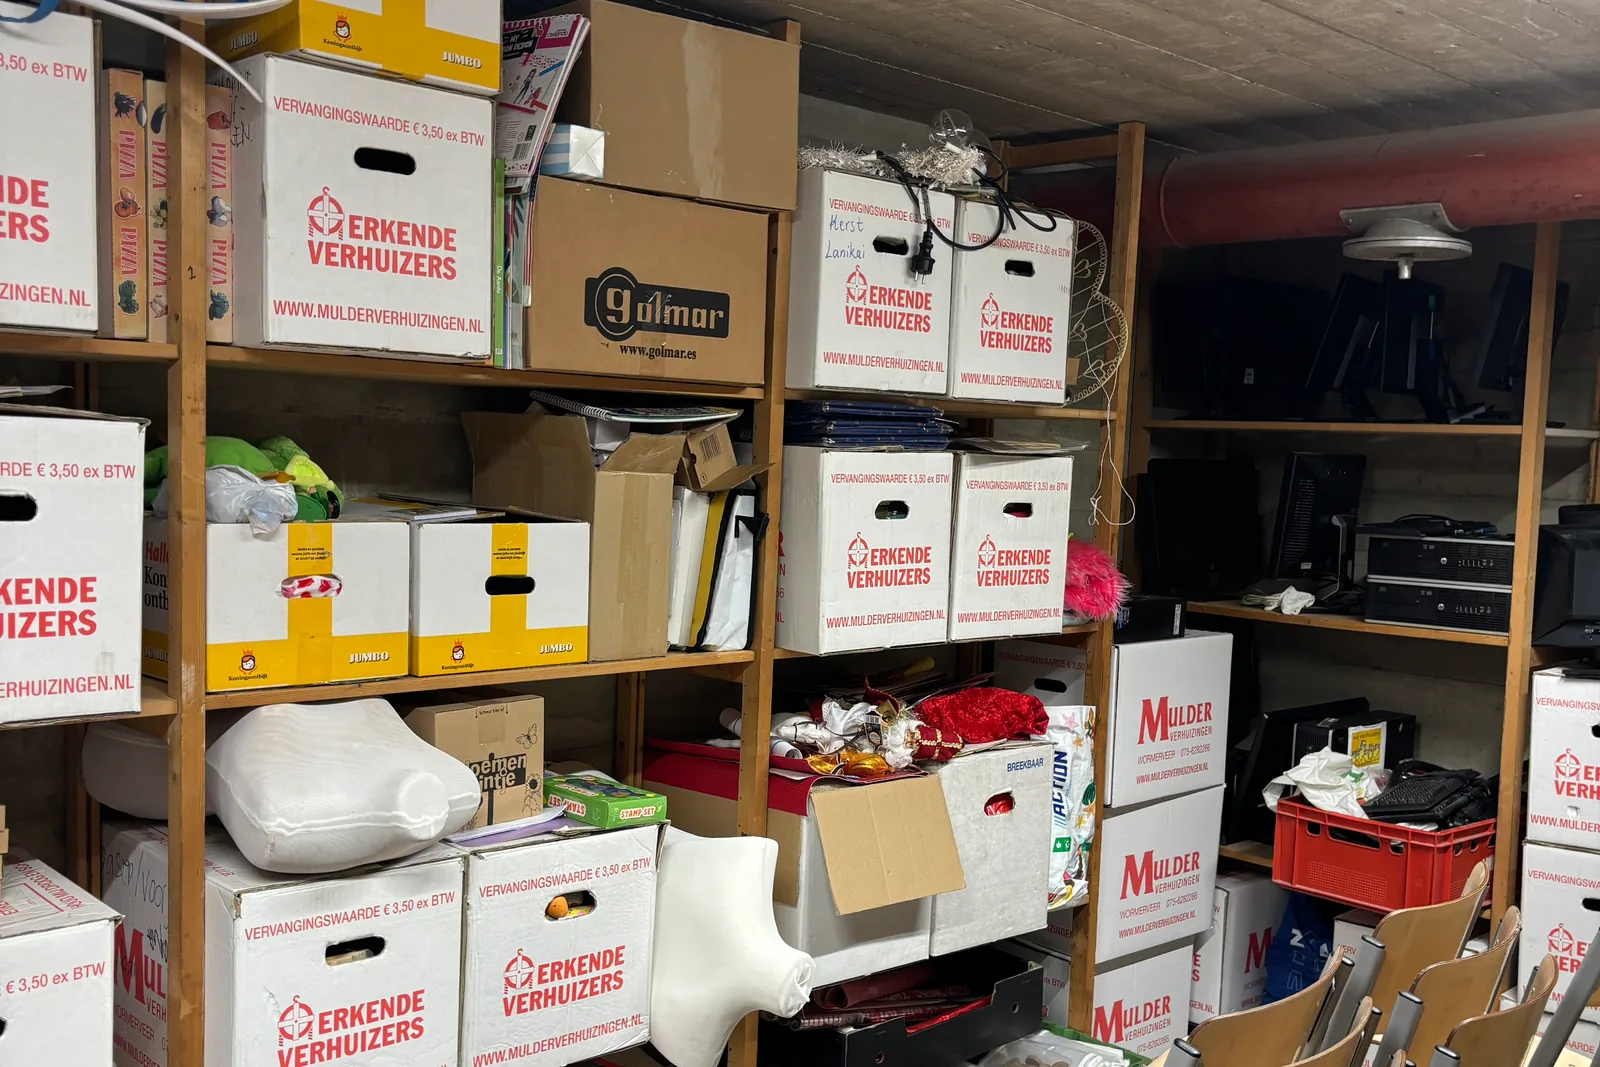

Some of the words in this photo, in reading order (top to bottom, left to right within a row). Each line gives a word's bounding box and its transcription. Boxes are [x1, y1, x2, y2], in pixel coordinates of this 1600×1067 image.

[230, 31, 258, 50] JUMBO
[31, 60, 49, 76] ex
[53, 62, 88, 83] BTW
[442, 51, 482, 69] JUMBO
[273, 96, 410, 133] VERVANGINGSWAARDE
[413, 122, 420, 135] €
[421, 124, 443, 140] 3,50
[445, 131, 458, 142] ex
[460, 131, 485, 147] BTW
[119, 130, 136, 179] PIZZA
[211, 142, 227, 190] PIZZA
[829, 198, 908, 221] VERVANGINGSWAARDE
[937, 217, 951, 229] BTW
[348, 214, 457, 252] ERKENDE
[121, 227, 138, 276] PIZZA
[212, 238, 228, 286] PIZZA
[307, 240, 457, 281] VERHUIZERS
[1058, 248, 1070, 258] BTW
[606, 287, 724, 329] golmar
[869, 285, 932, 311] ERKENDE
[273, 299, 485, 333] WWW.MULDERVERHUIZINGEN.NL
[845, 306, 931, 333] VERHUIZERS
[1001, 311, 1053, 333] ERKENDE
[619, 343, 697, 360] www.golmar.es
[980, 330, 1052, 354] VERHUIZERS
[823, 351, 945, 373] WWW.MULDERVERHUIZINGEN.NL
[961, 372, 1063, 390] WWW.MULDERVERHUIZINGEN.NL
[37, 464, 46, 478] €
[50, 464, 79, 480] 3,50
[83, 467, 99, 478] ex
[104, 465, 136, 479] BTW
[831, 473, 908, 484] VERVANGINGSWAARDE
[913, 474, 927, 485] 3,50
[927, 476, 934, 484] ex
[935, 474, 950, 484] BTW
[966, 480, 1032, 491] VERVANGINGSWAARDE
[1037, 481, 1048, 492] 3,50
[1056, 482, 1069, 491] BTW
[870, 546, 932, 566] ERKENDE
[997, 549, 1052, 567] ERKENDE
[847, 567, 931, 589] VERHUIZERS
[977, 568, 1050, 587] VERHUIZERS
[826, 609, 945, 629] WWW.MULDERVERHUIZINGEN.NL
[957, 608, 1061, 623] WWW.MULDERVERHUIZINGEN.NL
[348, 651, 390, 664] JUMBO
[539, 643, 573, 655] JUMBO
[1137, 696, 1212, 745] MULDER
[1170, 725, 1212, 742] VERHUIZINGEN
[1007, 757, 1044, 772] BREEKBAAR
[1137, 749, 1176, 764] WORMERVEER
[1052, 750, 1068, 818] ACTION
[1136, 762, 1209, 784] WWW.MULDERVERHUIZINGEN.NL
[620, 808, 642, 819] STAMP
[643, 807, 655, 816] SET
[479, 868, 593, 898] VERVANGINGSWAARDE
[595, 867, 600, 878] €
[602, 863, 619, 878] 3,50
[621, 862, 631, 873] ex
[632, 857, 651, 871] BTW
[1119, 849, 1200, 900] MULDER
[1155, 874, 1200, 894] VERHUIZINGEN
[245, 905, 380, 941] VERVANGINGSWAARDE
[383, 903, 390, 916] €
[392, 900, 414, 916] 3,50
[416, 898, 429, 909] ex
[431, 891, 455, 907] BTW
[1119, 901, 1161, 919] WORMERVEER
[1118, 910, 1196, 939] WWW.MULDERVERHUIZINGEN.NL
[537, 945, 625, 985] ERKENDE
[5, 981, 15, 994] €
[18, 974, 48, 993] 3,50
[52, 972, 69, 985] ex
[73, 961, 105, 981] BTW
[503, 970, 624, 1017] VERHUIZERS
[318, 989, 425, 1035] ERKENDE
[473, 1013, 644, 1067] WWW.MULDERVERHUIZINGEN.NL
[1125, 1017, 1171, 1042] VERHUIZINGEN
[277, 1017, 424, 1067] VERHUIZERS
